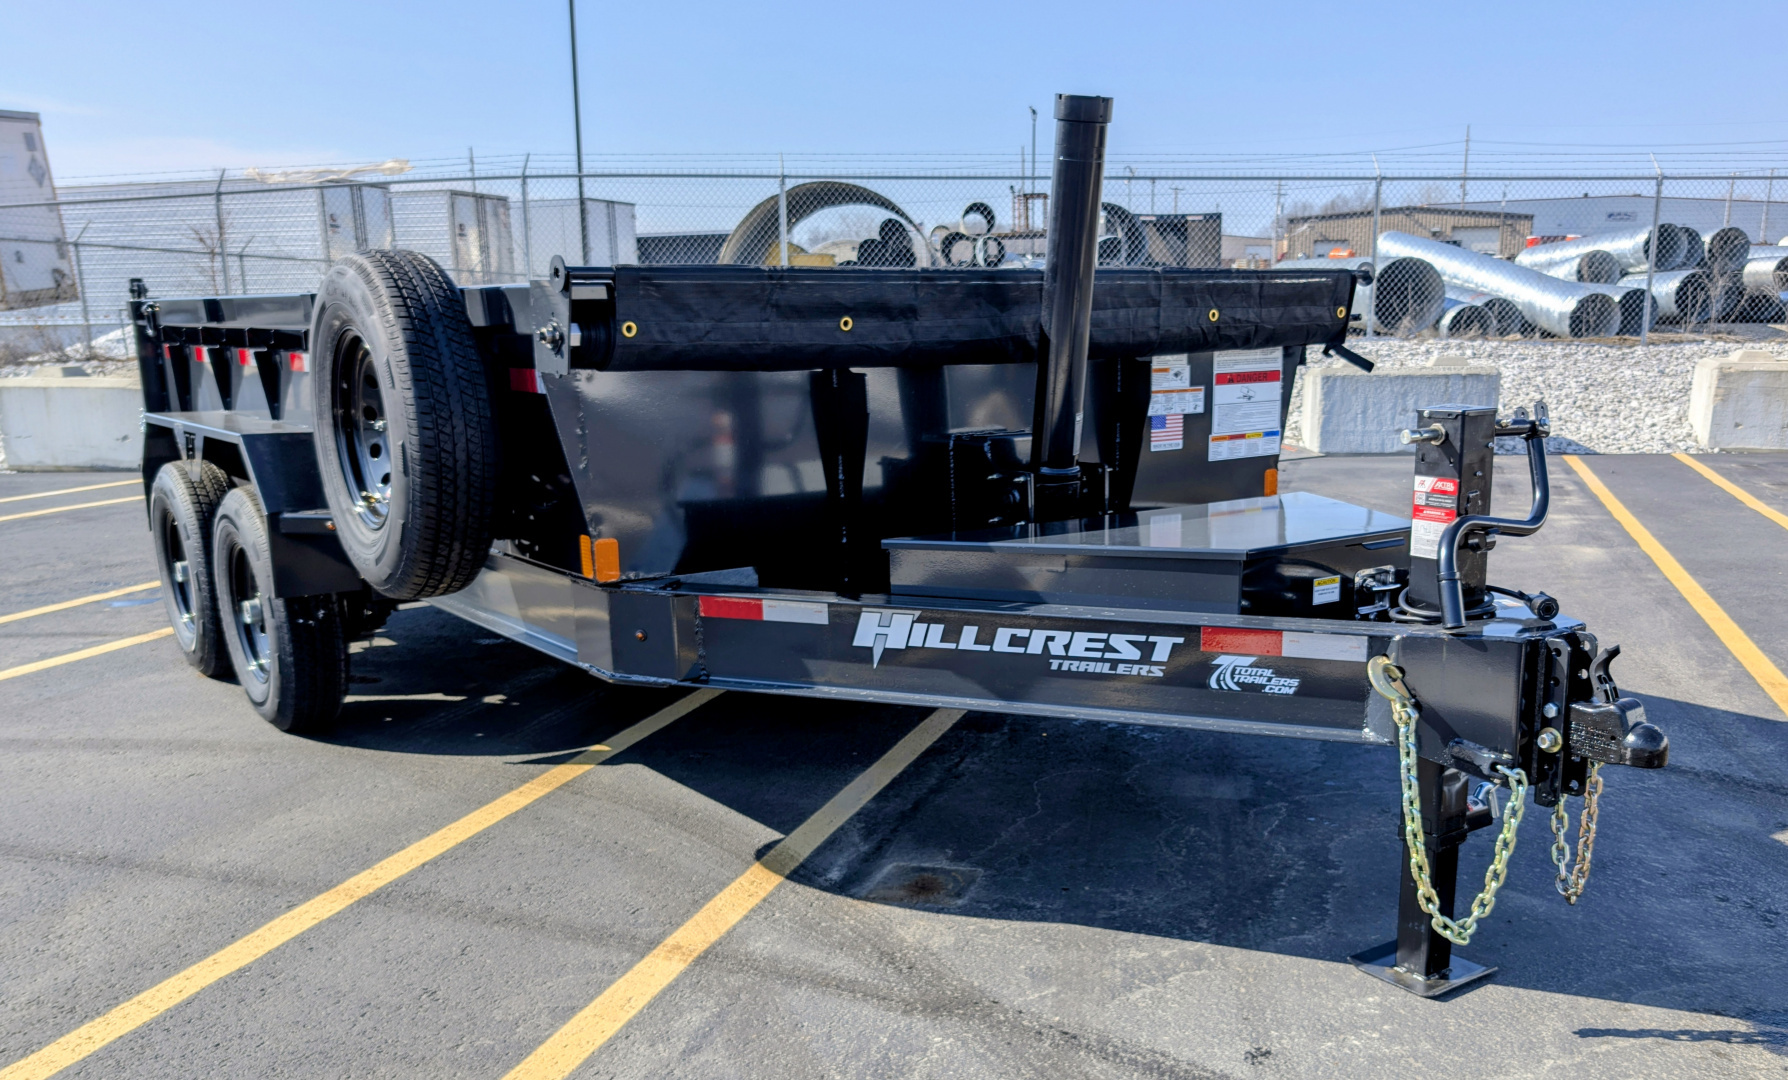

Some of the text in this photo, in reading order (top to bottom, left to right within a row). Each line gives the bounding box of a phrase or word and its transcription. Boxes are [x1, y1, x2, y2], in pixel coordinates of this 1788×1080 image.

[1236, 373, 1268, 383] DANGER
[852, 608, 1185, 668] HILLCREST
[1049, 659, 1166, 677] TRAILERS
[1235, 666, 1276, 677] TOTAL
[1233, 675, 1300, 687] TRAILERS
[1261, 685, 1296, 695] .COM
